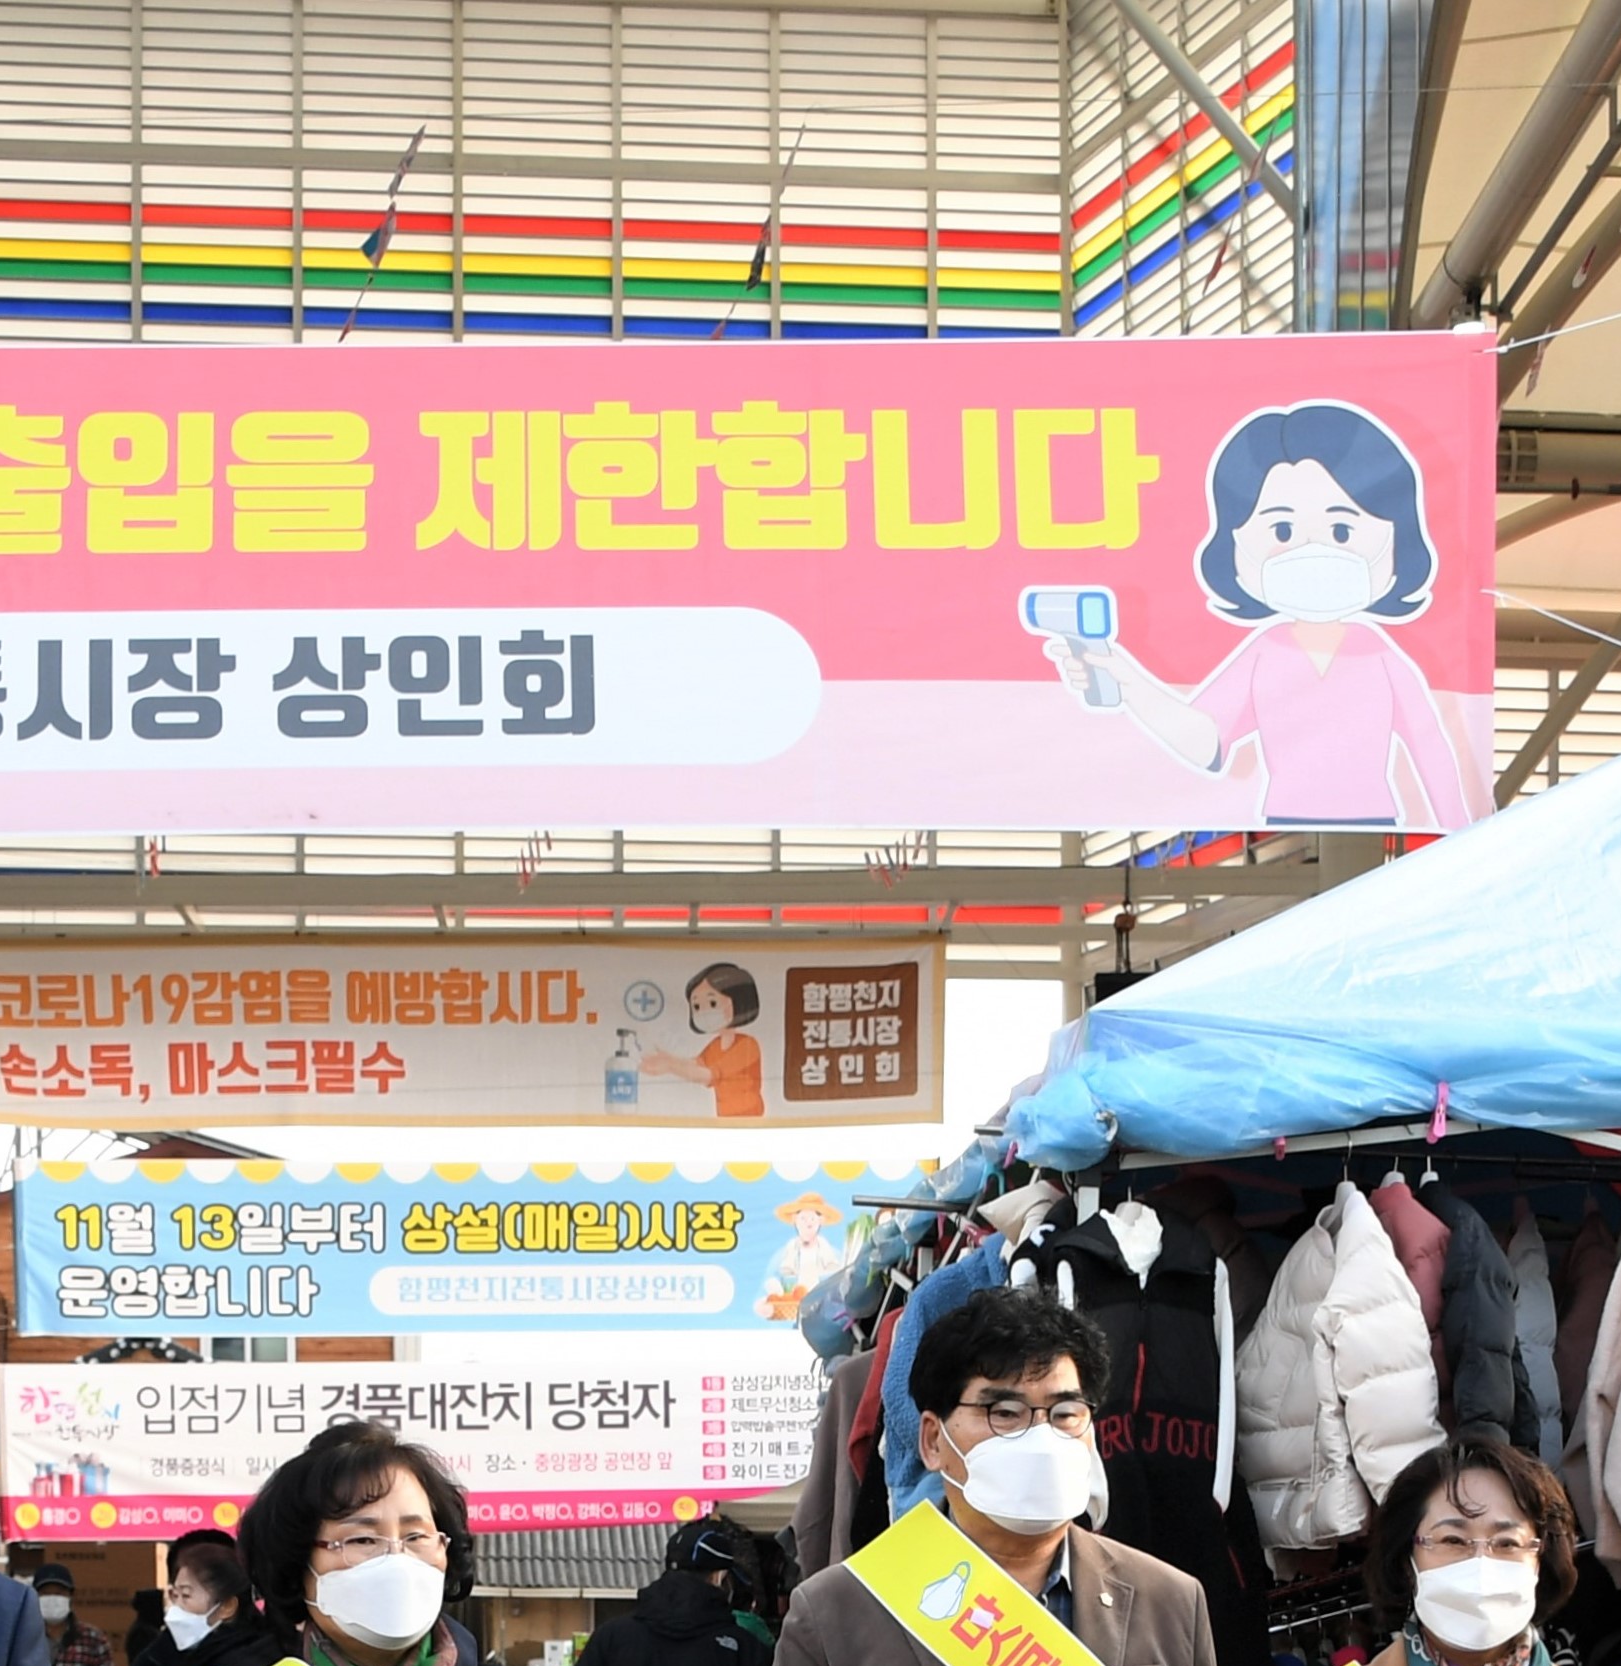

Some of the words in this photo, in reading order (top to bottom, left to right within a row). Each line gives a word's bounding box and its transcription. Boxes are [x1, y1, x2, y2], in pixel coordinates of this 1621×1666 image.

[417, 400, 1160, 552] 제한합니다
[271, 627, 597, 741] 상인회
[345, 967, 598, 1026] 예방합시다.
[801, 979, 901, 1013] 함평천지
[801, 1016, 902, 1050] 전통시장
[0, 1042, 151, 1103] 손소독,
[168, 1040, 406, 1095] 마스크필수
[55, 1202, 157, 1255] 11월
[171, 1202, 386, 1254] 13일부터
[401, 1201, 744, 1254] 상설(매일)시장
[57, 1264, 320, 1318] 운영합니다
[397, 1275, 707, 1303] 함평천지전통시장상인회
[136, 1383, 306, 1435] 입점기념
[320, 1381, 533, 1433] 경품대잔치
[547, 1380, 676, 1430] 당첨자
